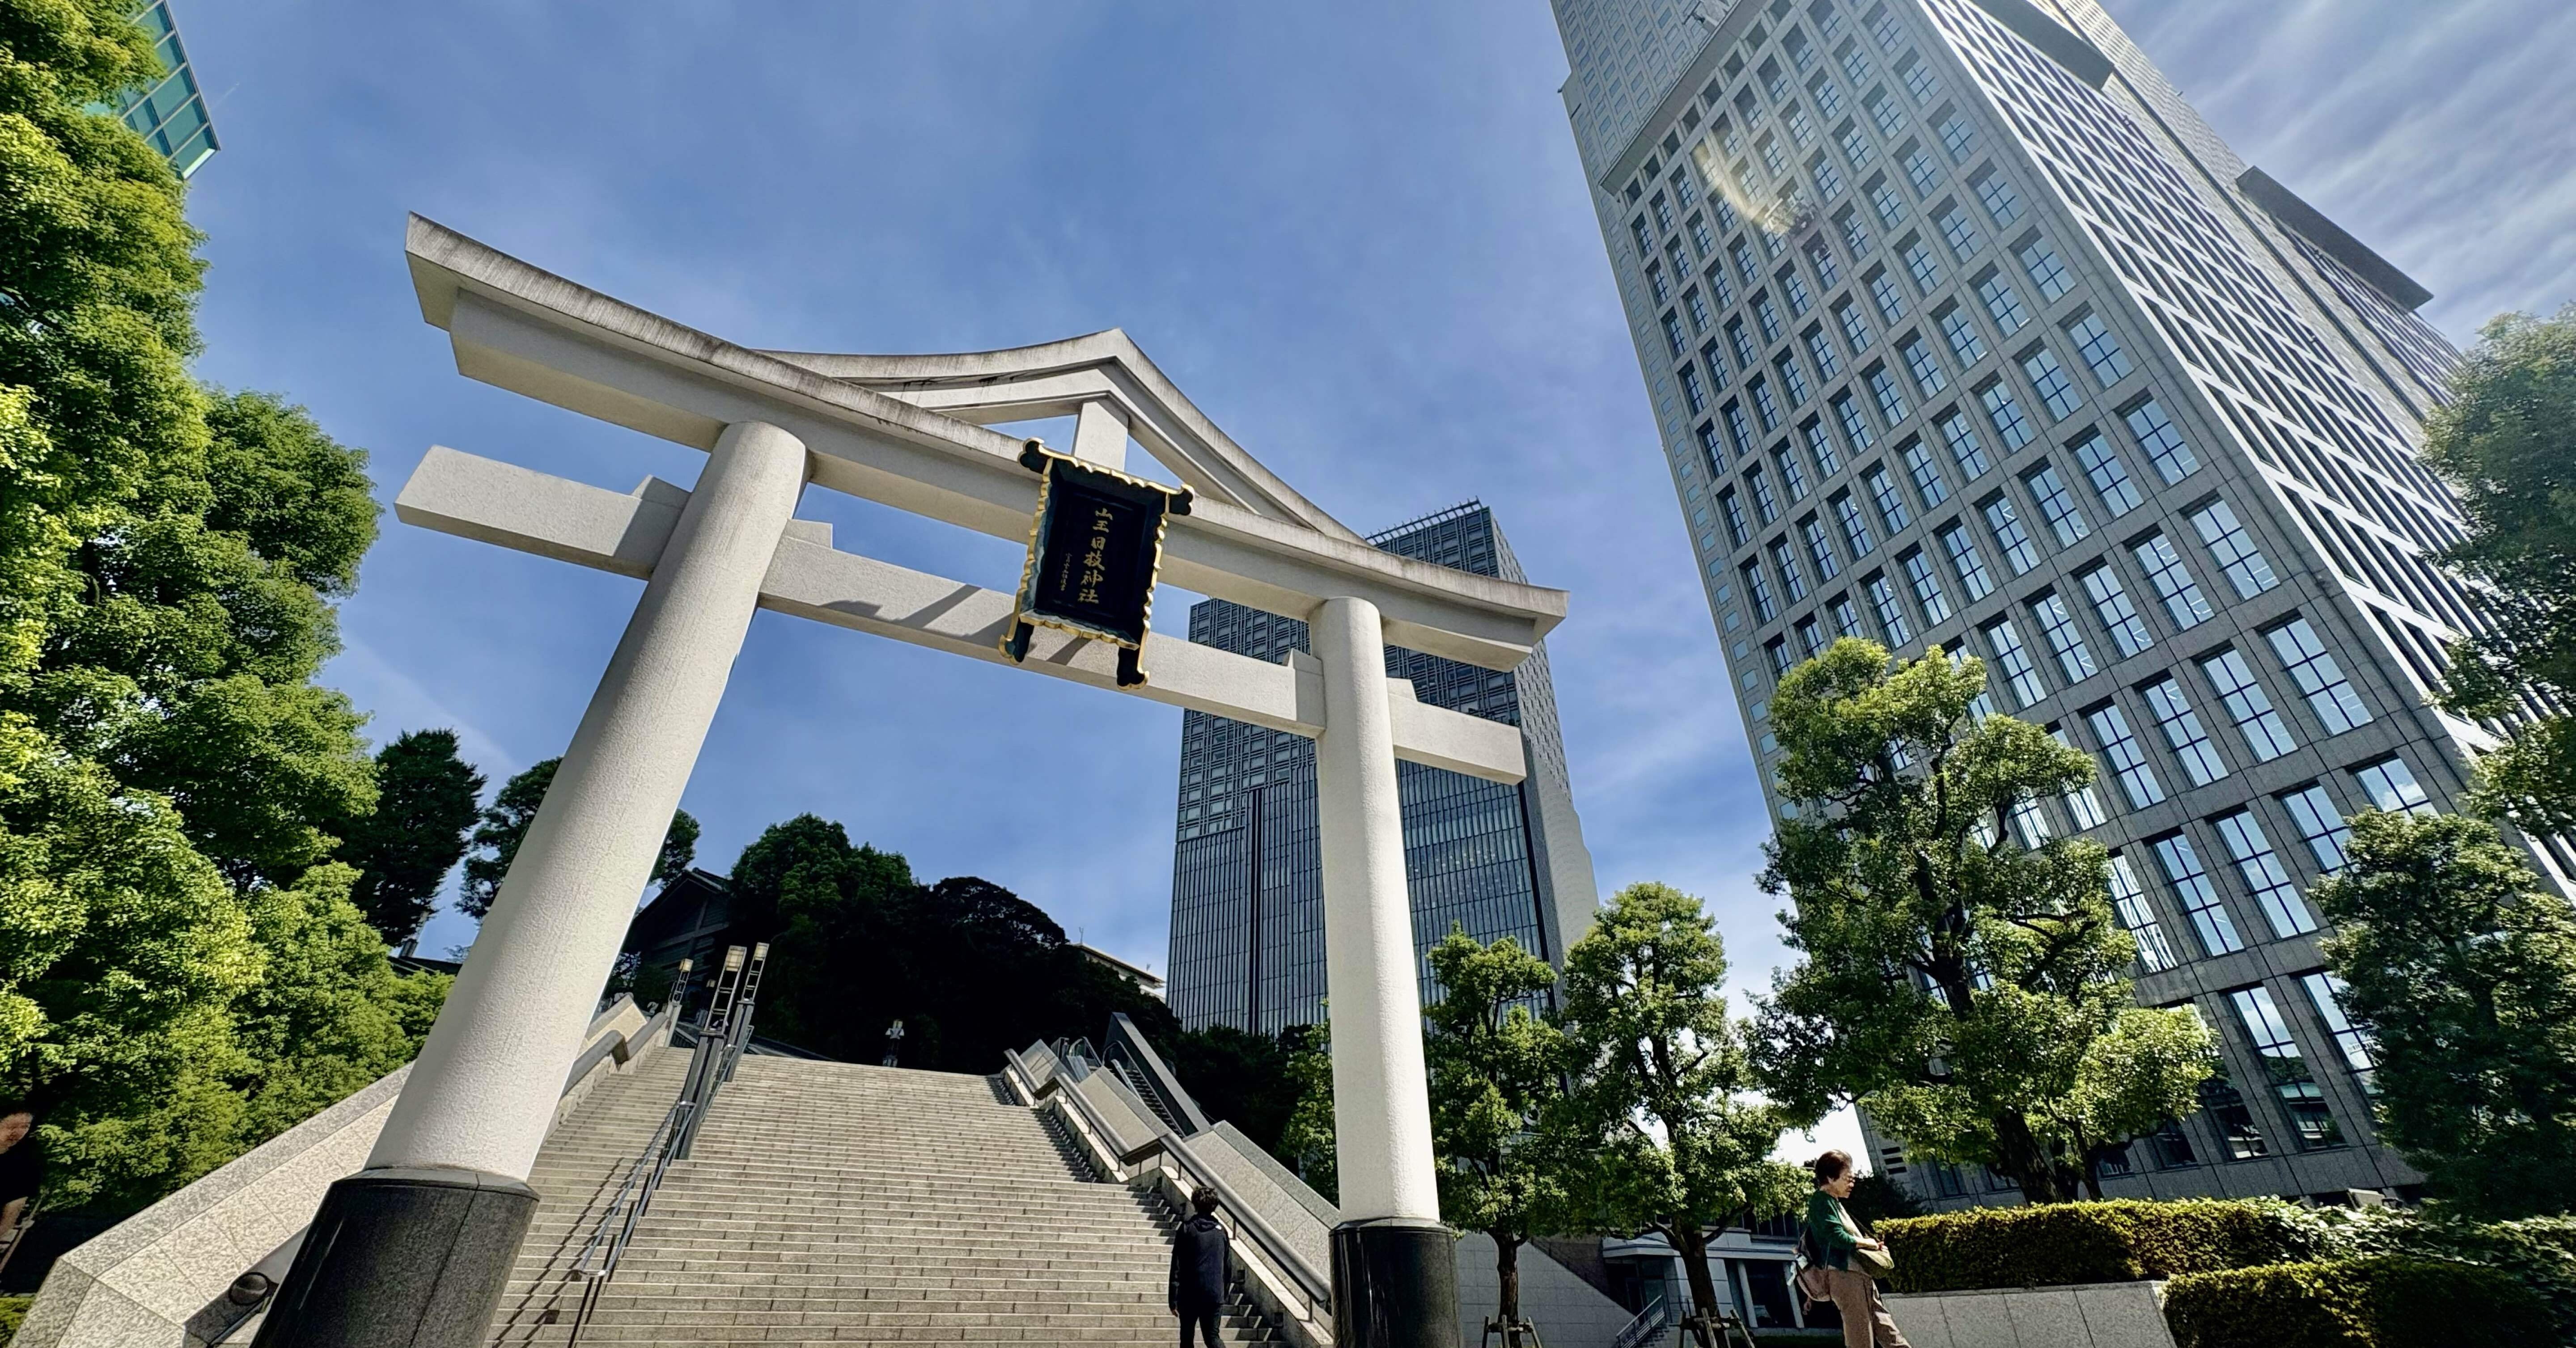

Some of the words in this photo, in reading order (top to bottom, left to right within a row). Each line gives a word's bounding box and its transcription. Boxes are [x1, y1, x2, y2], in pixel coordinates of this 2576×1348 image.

[1078, 508, 1113, 604] 山王日枝神社
